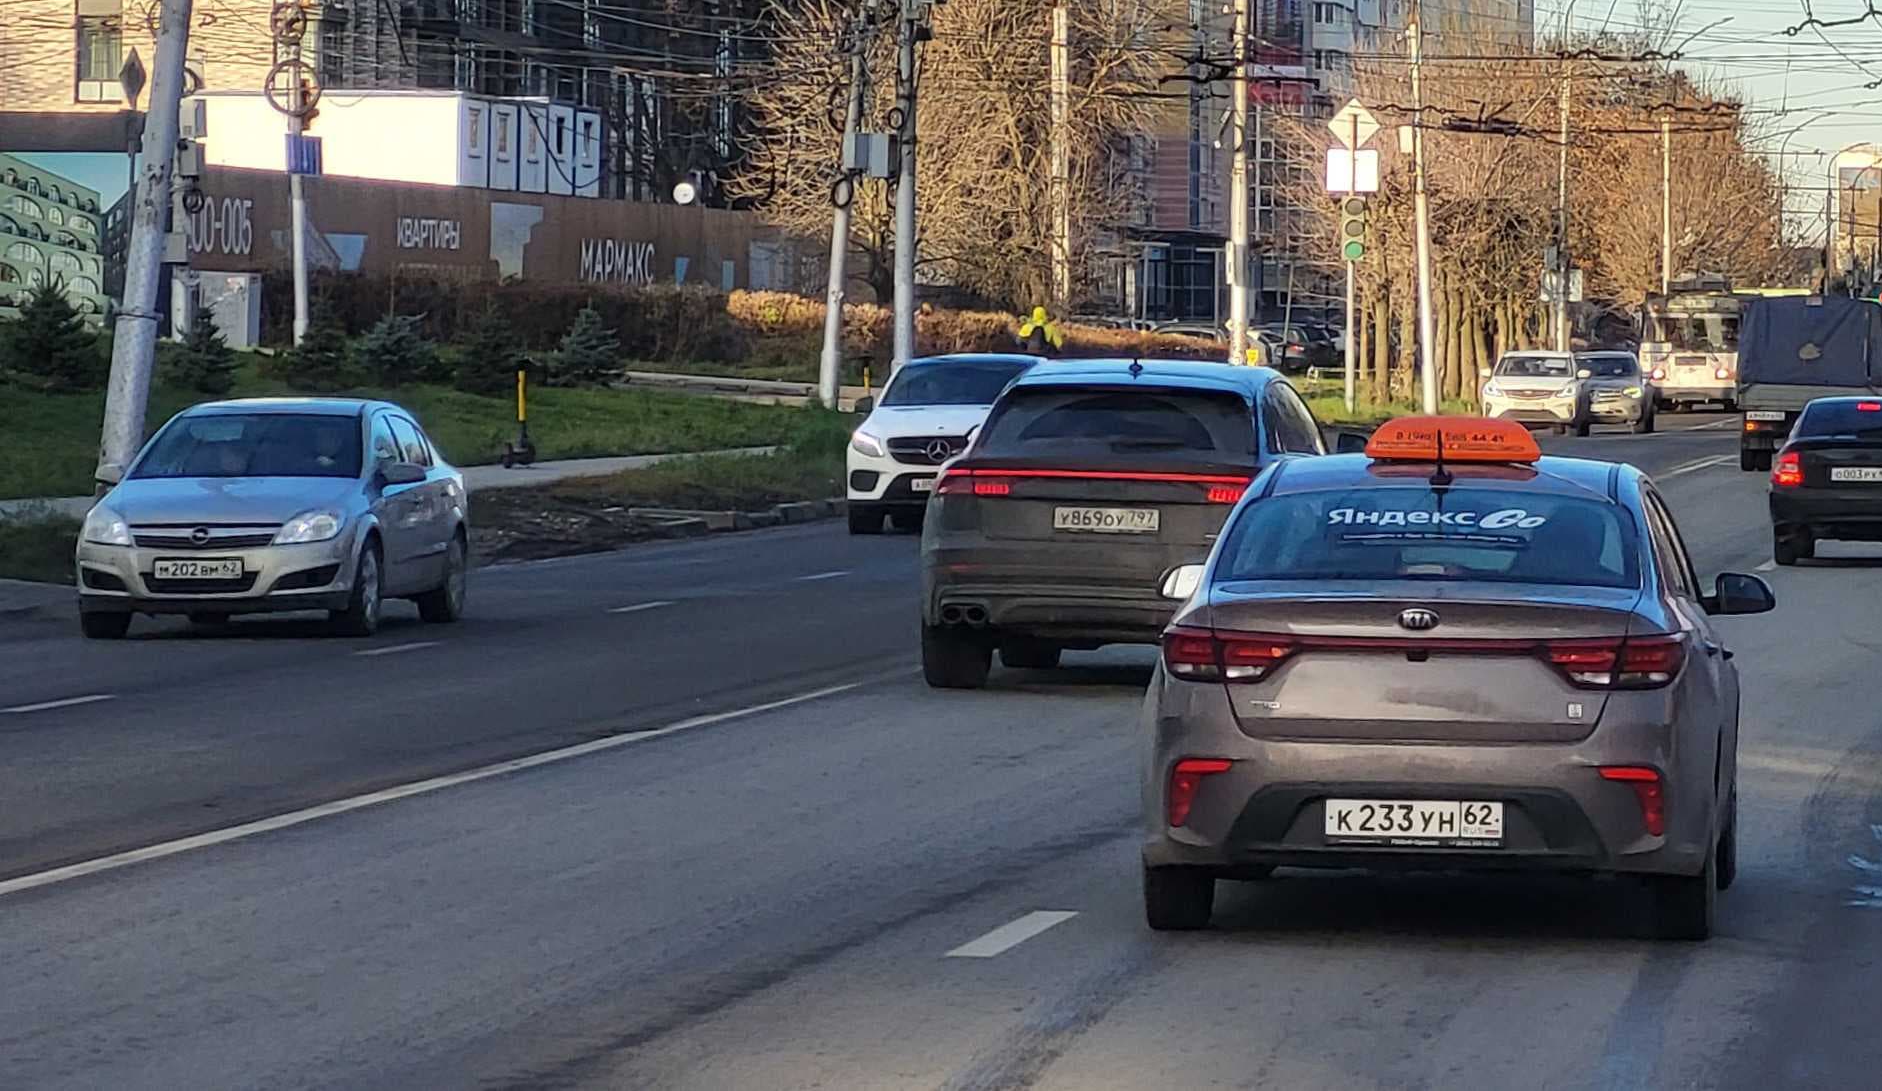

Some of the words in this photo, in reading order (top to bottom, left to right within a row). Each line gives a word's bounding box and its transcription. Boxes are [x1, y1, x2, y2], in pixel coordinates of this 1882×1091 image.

[396, 217, 461, 250] КВАРТИРЫ
[580, 237, 656, 287] МАРМАКС
[1327, 508, 1476, 527] Яндекс
[1478, 508, 1547, 529] Go
[1402, 612, 1434, 628] KIA
[1463, 803, 1493, 826] 62
